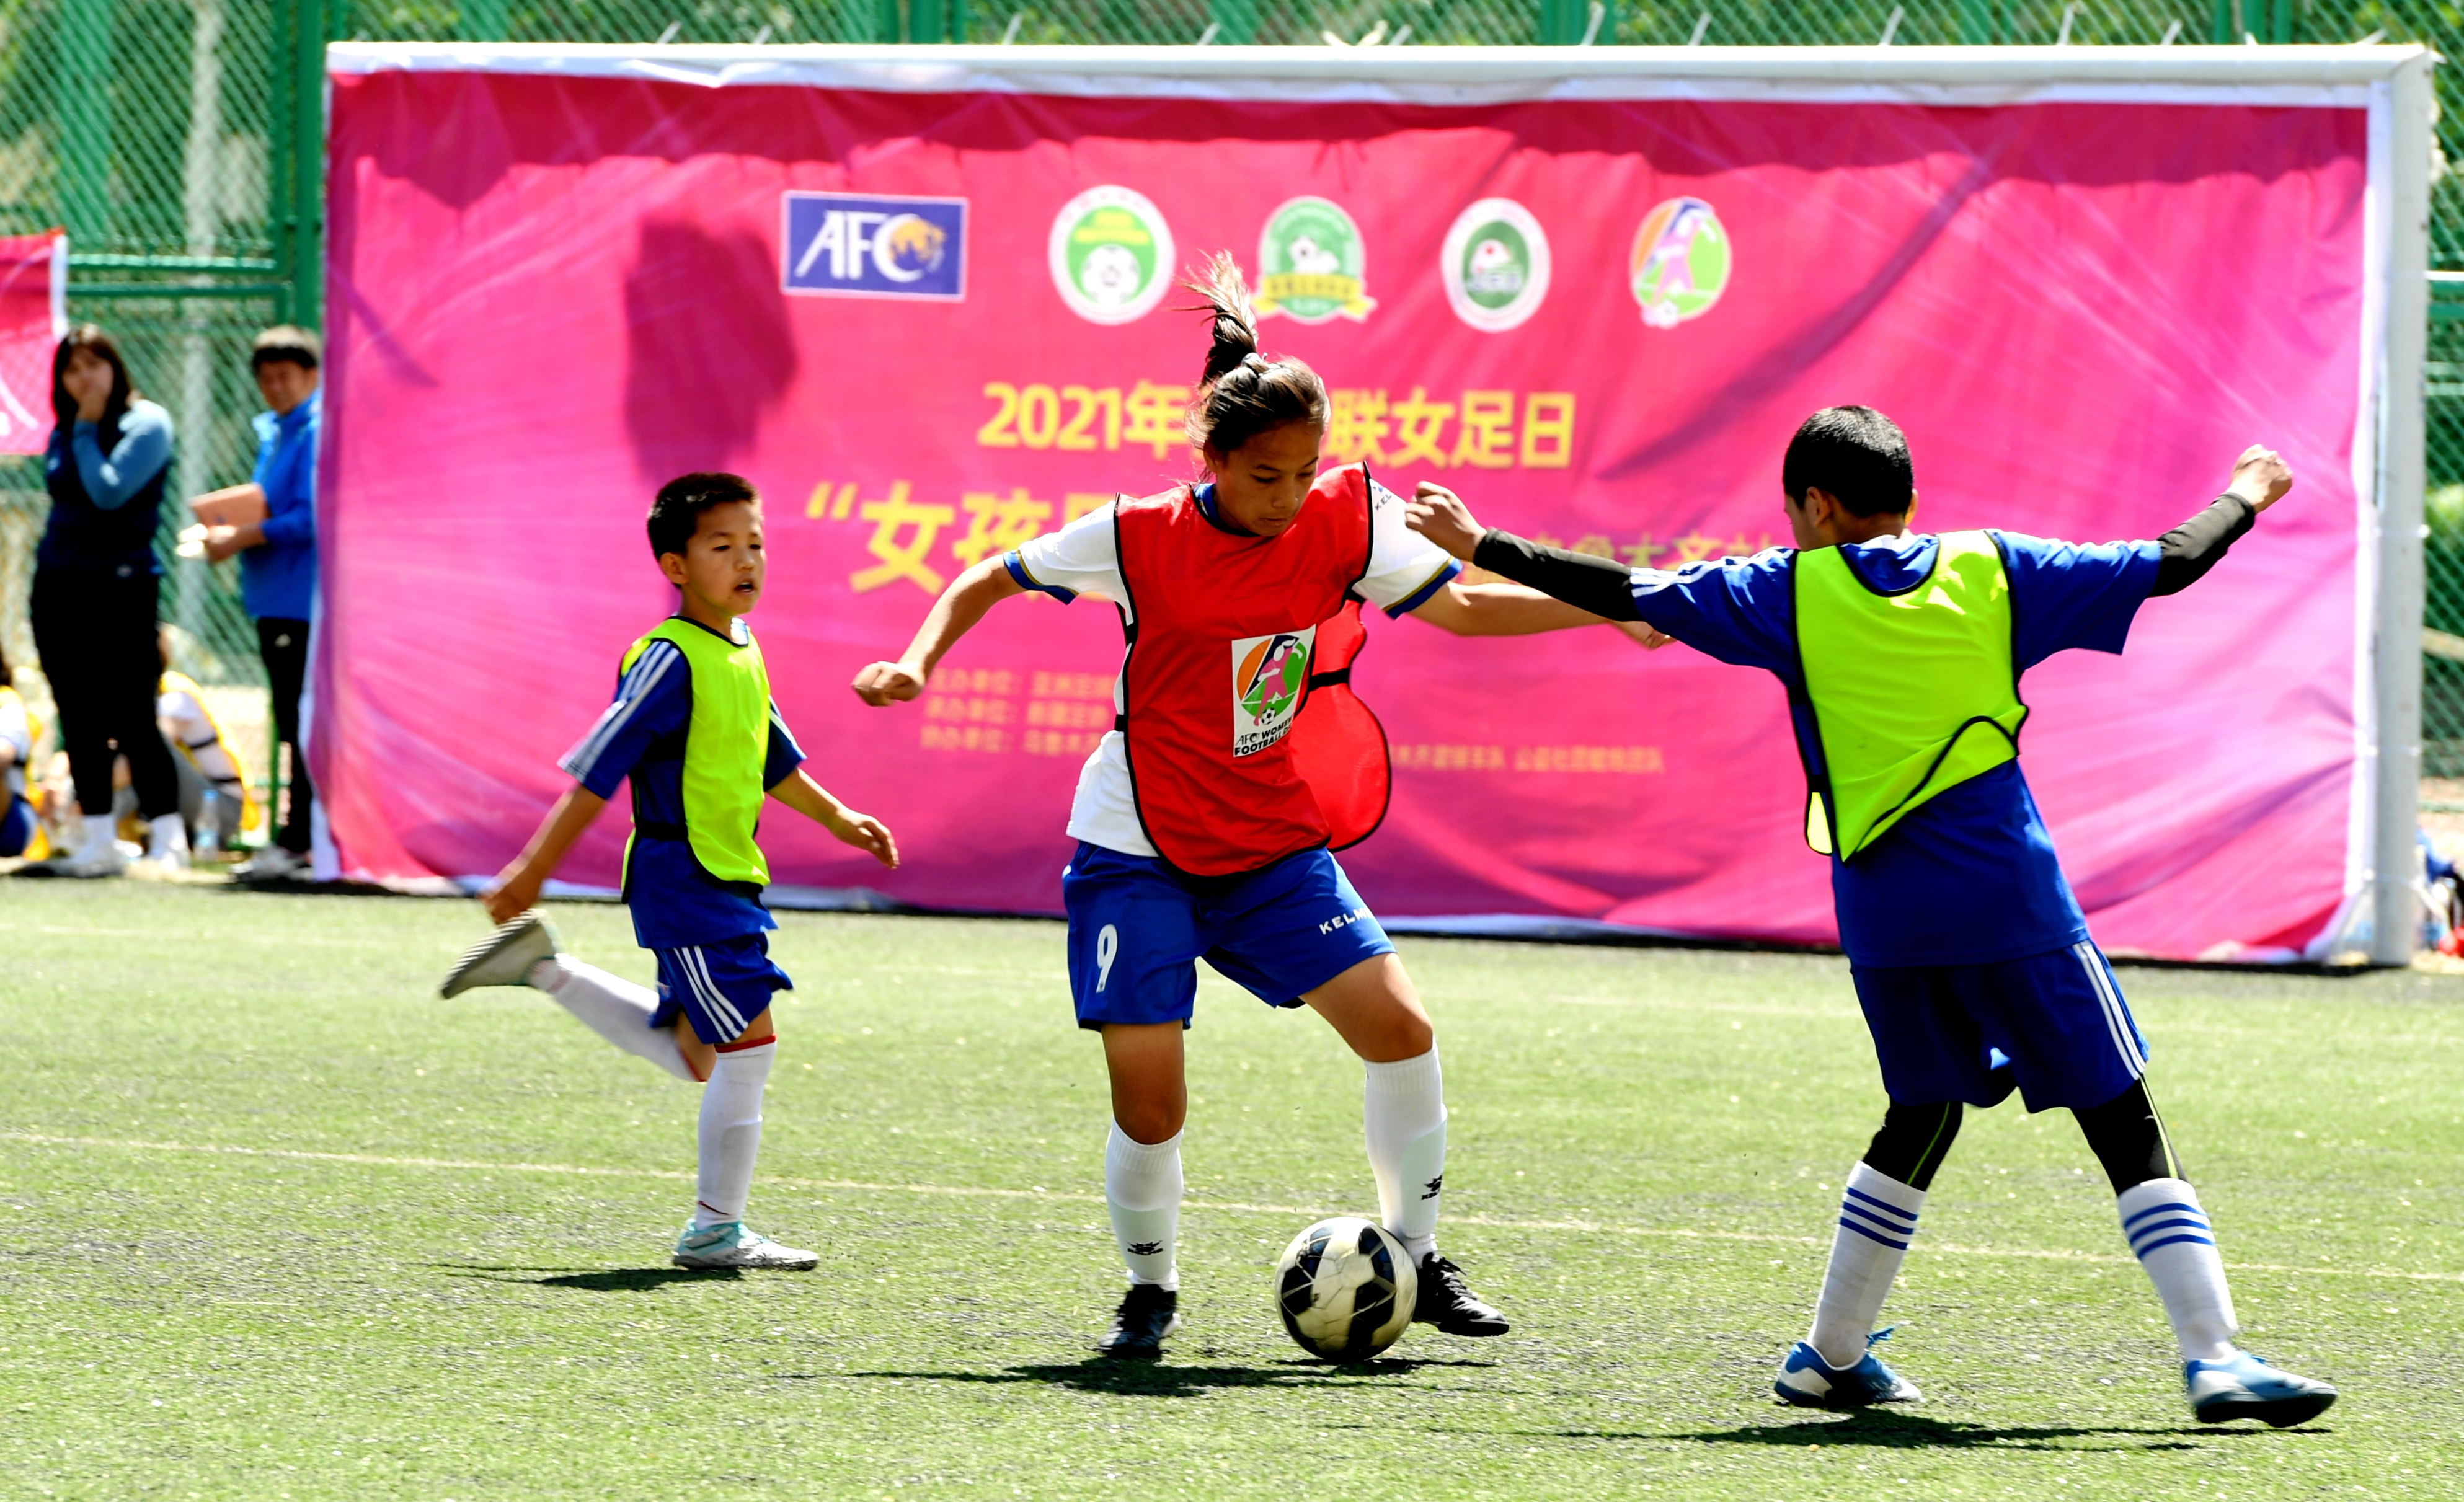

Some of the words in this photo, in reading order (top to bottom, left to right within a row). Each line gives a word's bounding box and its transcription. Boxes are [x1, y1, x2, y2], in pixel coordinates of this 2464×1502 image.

[794, 210, 946, 283] AFC
[977, 379, 1576, 469] 2021年联女足日
[1235, 732, 1260, 746] AFC
[1235, 731, 1282, 756] FOOTBALL
[1096, 924, 1117, 992] 9
